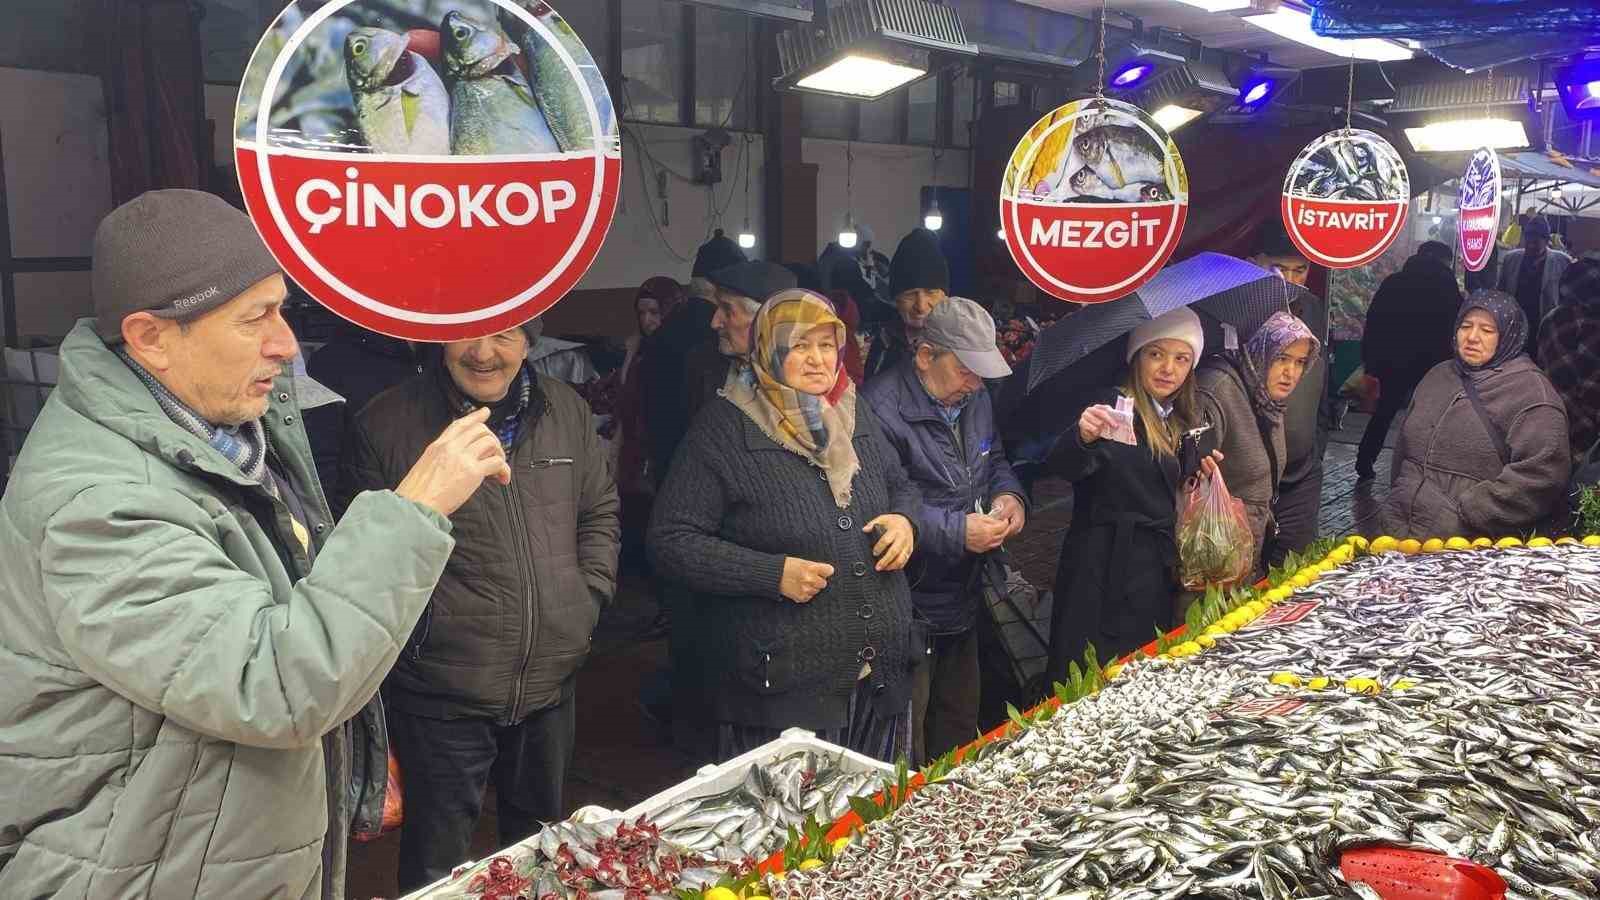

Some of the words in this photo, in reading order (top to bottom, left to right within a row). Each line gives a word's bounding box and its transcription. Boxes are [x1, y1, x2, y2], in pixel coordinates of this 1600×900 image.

[295, 167, 577, 234] ÇİNOKOP
[1298, 203, 1389, 230] İSTAVRİT
[1030, 211, 1161, 248] MEZGİT
[173, 286, 220, 310] Reebok
